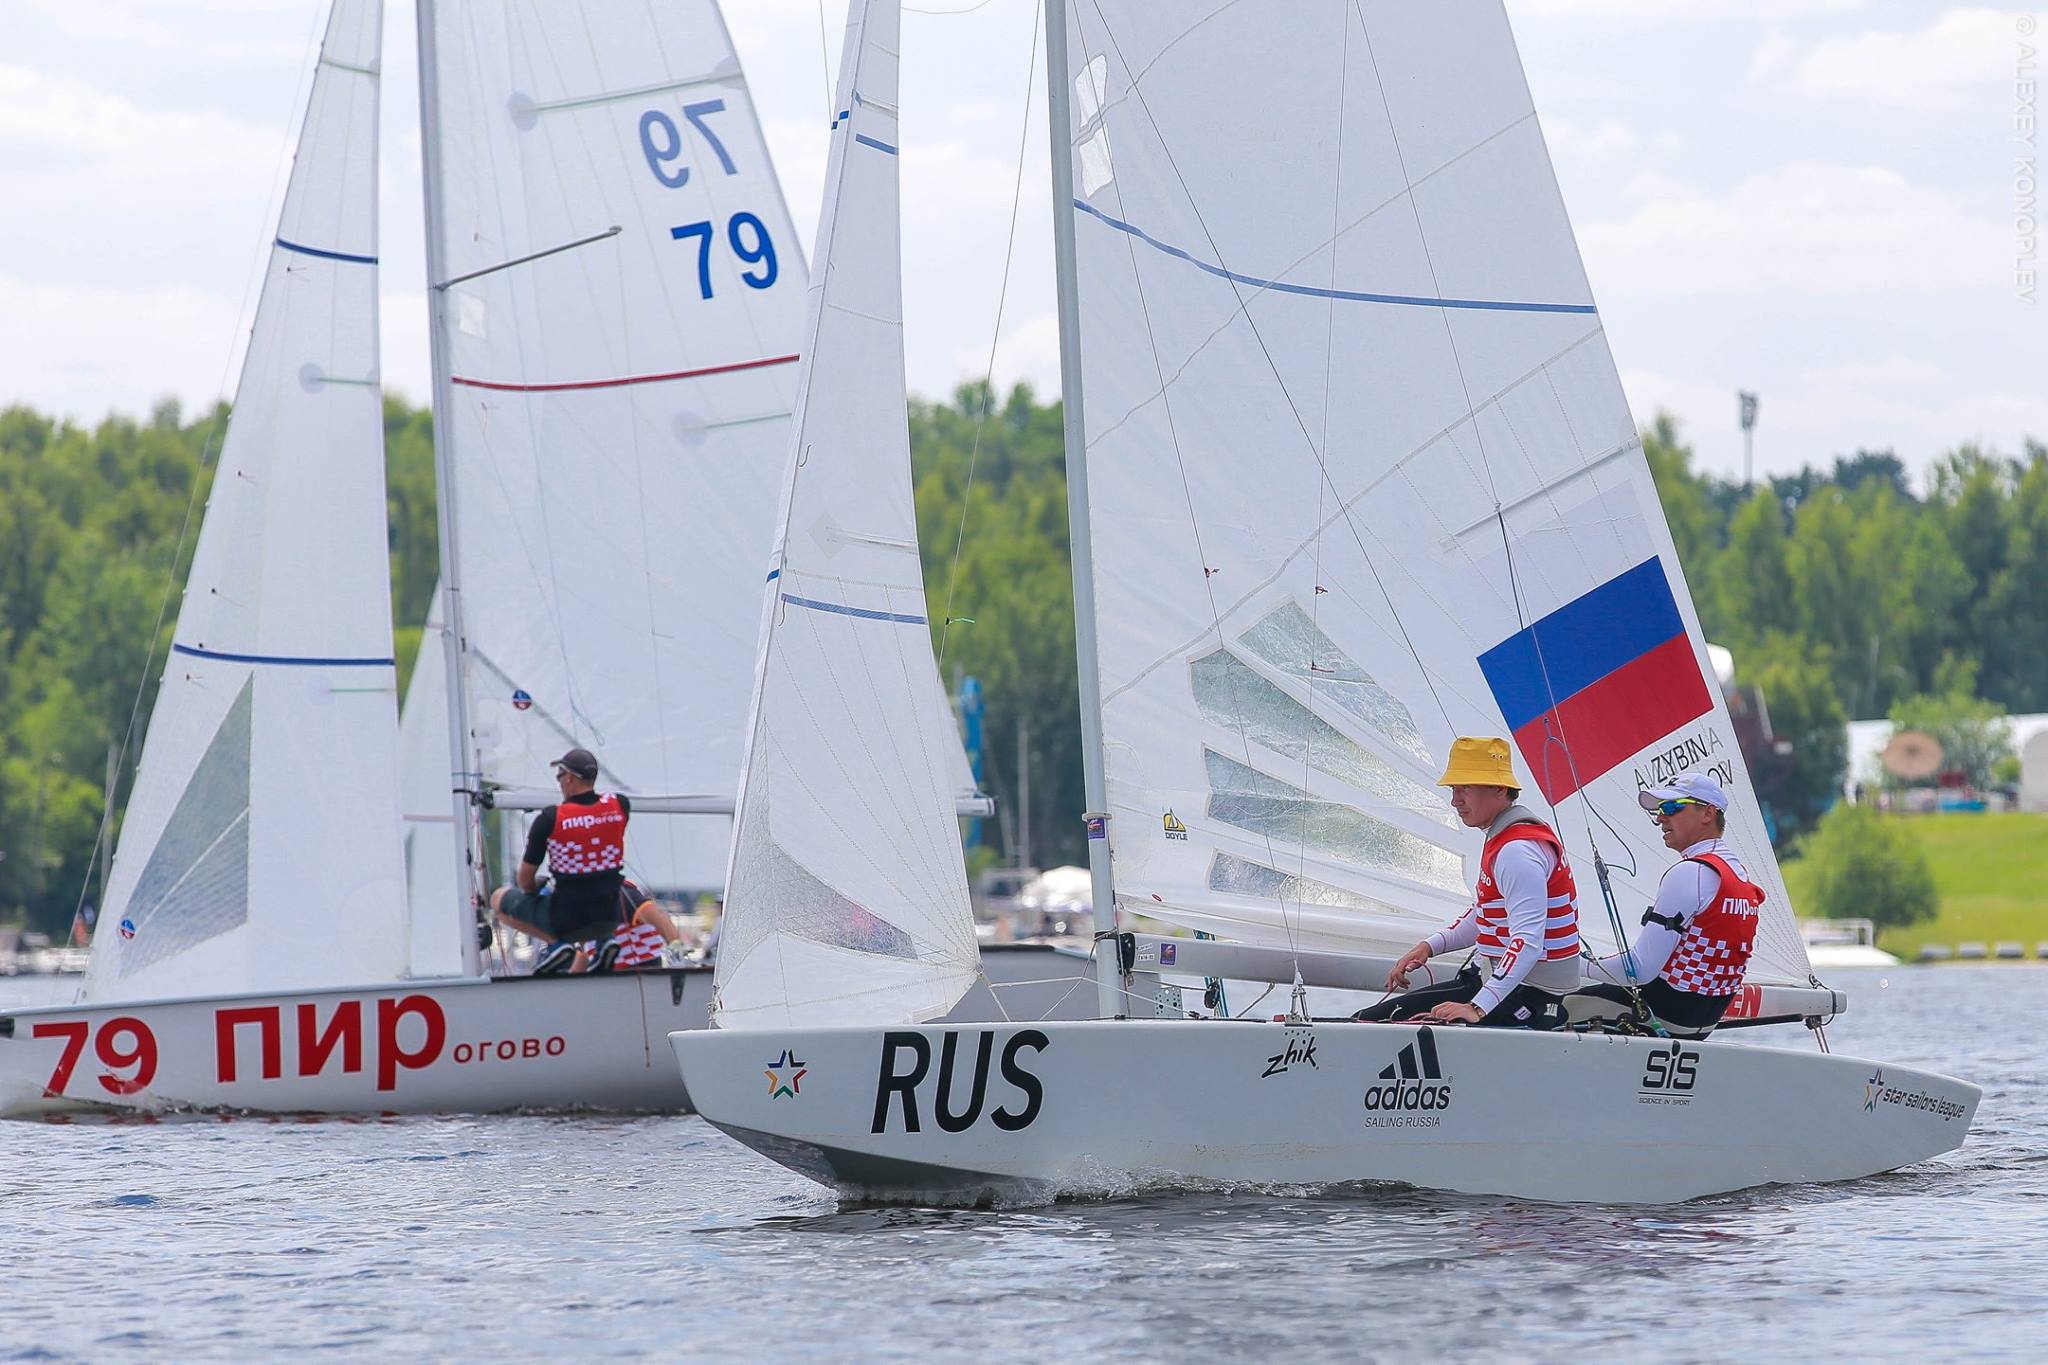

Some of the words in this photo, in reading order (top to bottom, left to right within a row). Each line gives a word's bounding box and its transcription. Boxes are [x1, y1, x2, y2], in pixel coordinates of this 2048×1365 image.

[670, 211, 778, 300] 79
[1165, 832, 1188, 841] DOYLE
[33, 1017, 158, 1098] 79
[1261, 1036, 1318, 1078] zhik
[870, 1029, 1050, 1134] RUS
[1364, 1079, 1450, 1110] adidas
[1365, 1117, 1403, 1128] SAILING
[1406, 1117, 1441, 1127] RUSSIA
[1883, 1087, 1907, 1104] star
[1905, 1091, 1938, 1113] sailors
[1936, 1096, 1965, 1121] league
